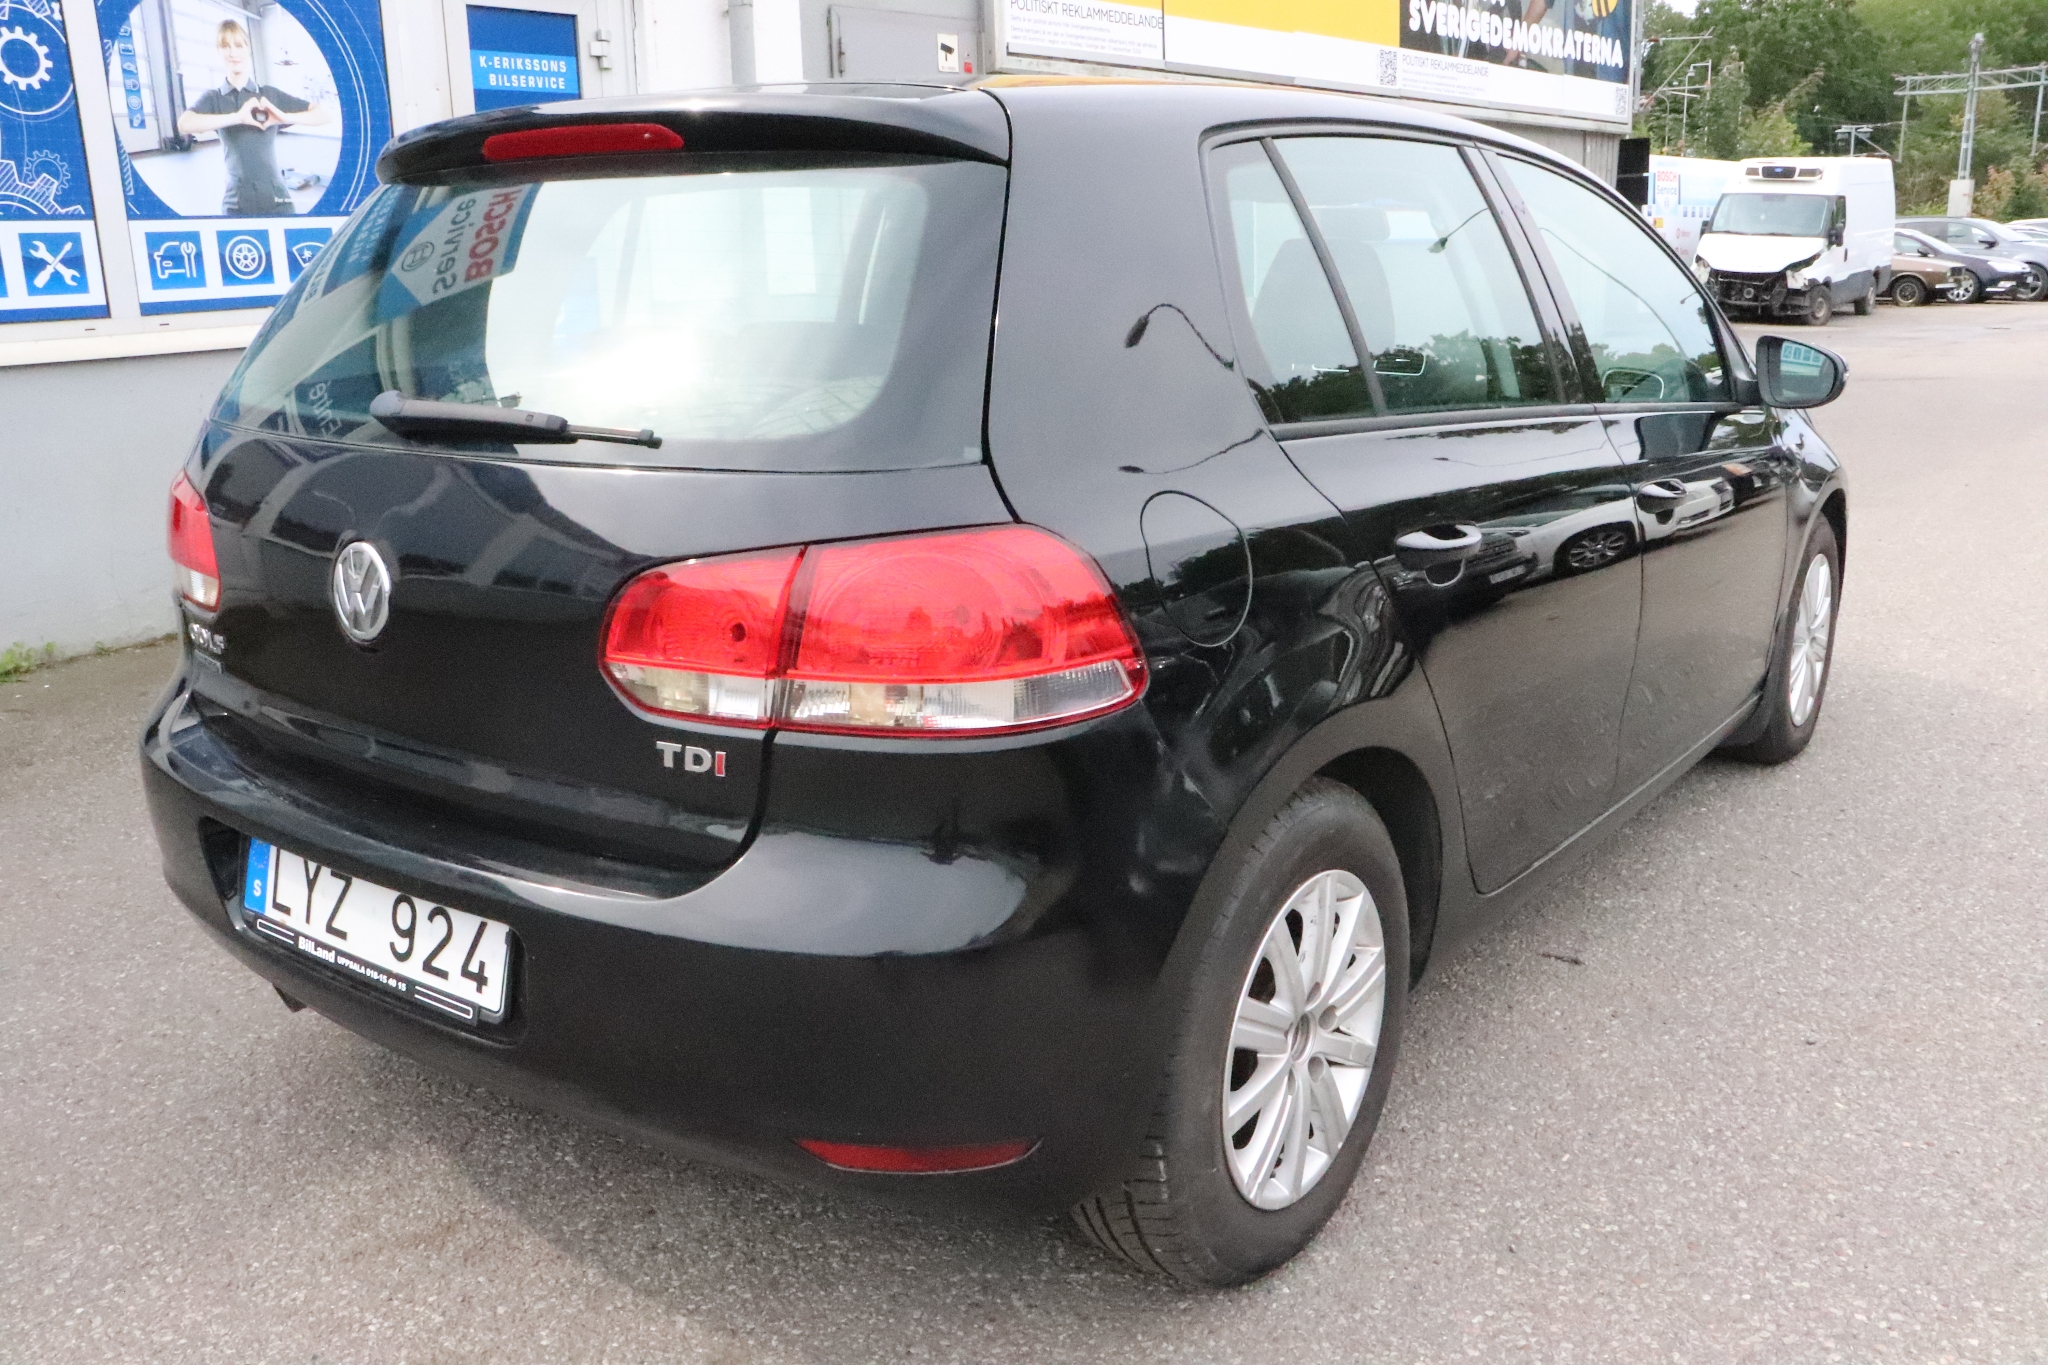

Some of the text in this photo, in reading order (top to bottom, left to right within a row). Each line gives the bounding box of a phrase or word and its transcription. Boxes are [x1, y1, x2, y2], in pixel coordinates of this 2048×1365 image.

[1010, 0, 1059, 15] POLITISKT
[1062, 2, 1163, 30] REKLAMMEDDELANDE
[1409, 0, 1624, 69] SVERIGEDEMOKRATERNA
[479, 55, 567, 73] K-ERIKSSONS
[1402, 54, 1489, 78] POLITISKT REKLAMMEDDELANDE
[489, 73, 566, 89] BILSERVICE
[1657, 171, 1678, 182] BOSCH
[1657, 184, 1678, 196] Service
[253, 847, 489, 995] S LYZ 924
[298, 936, 335, 963] BilLand
[337, 955, 366, 975] UPPSALA
